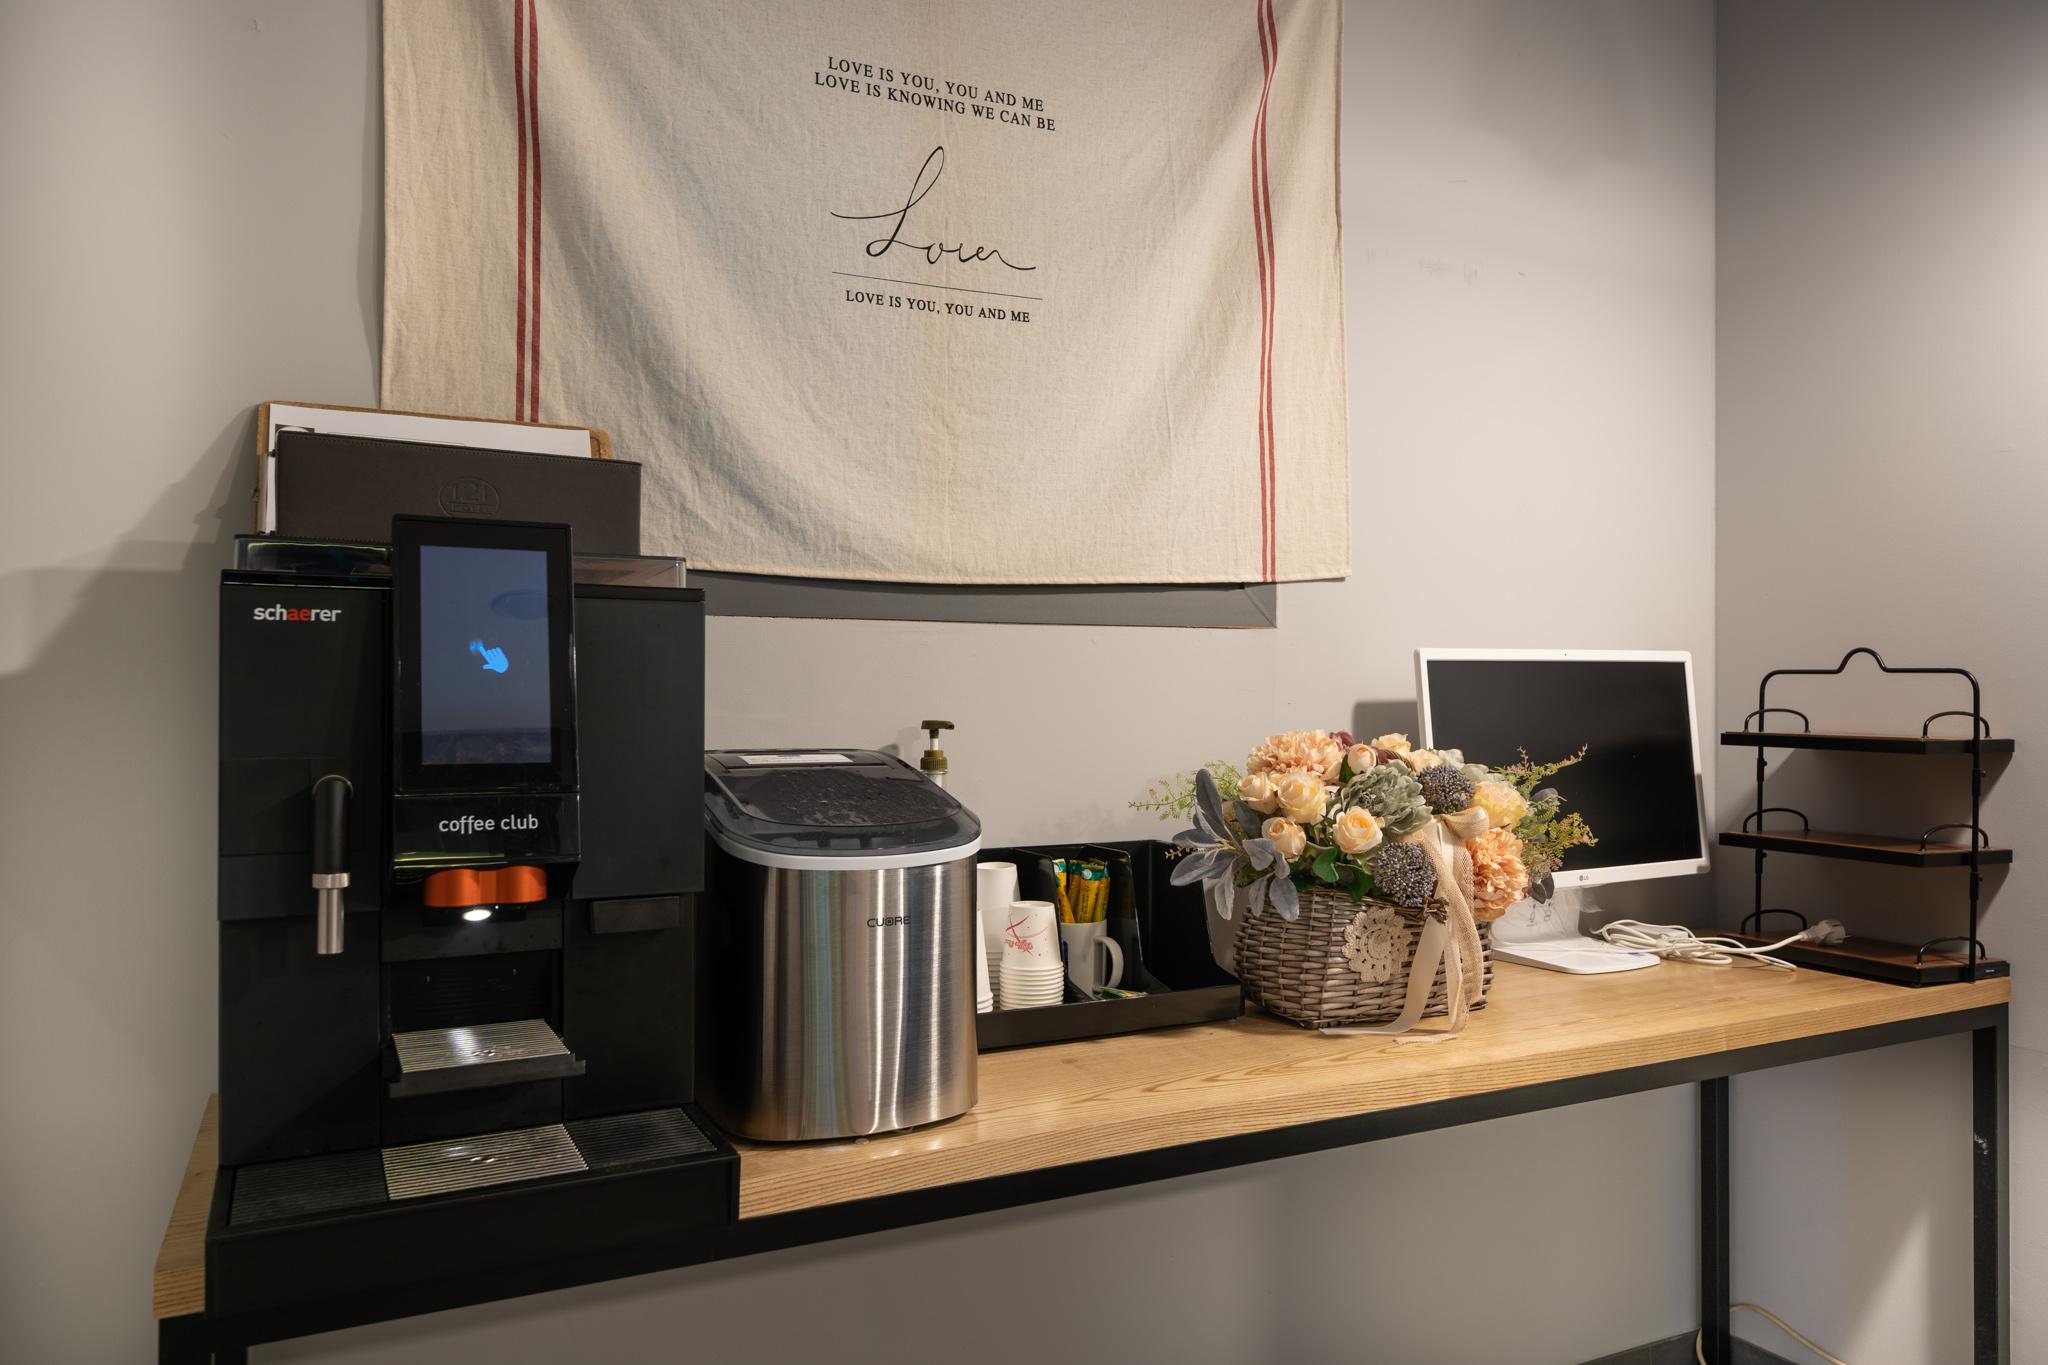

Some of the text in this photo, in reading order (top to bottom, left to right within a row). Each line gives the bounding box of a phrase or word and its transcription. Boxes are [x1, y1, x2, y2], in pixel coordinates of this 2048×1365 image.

[828, 56, 1044, 112] LOVE IS YOU, YOU AND ME
[814, 72, 1056, 132] LOVE IS KNOWING WE CAN BE
[846, 290, 1030, 322] LOVE IS YOU, YOU AND ME
[253, 604, 342, 622] schaerer
[439, 814, 539, 835] coffee club
[866, 915, 912, 928] CUORE
